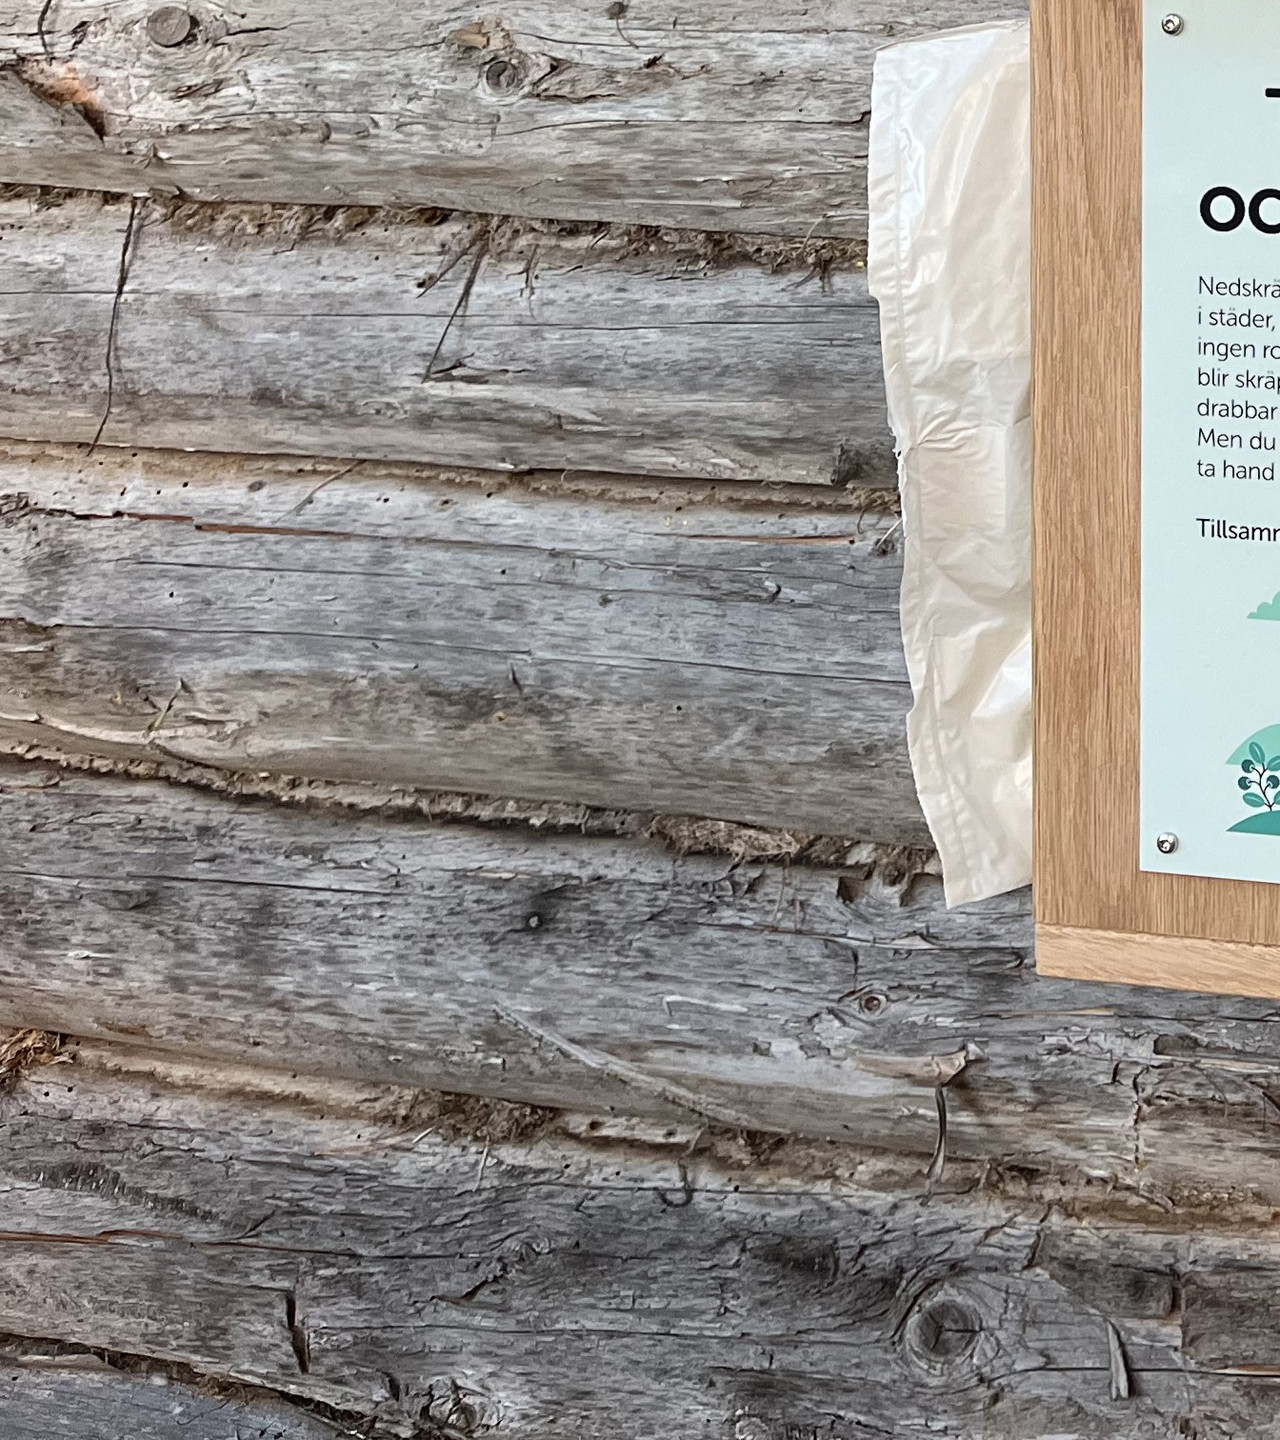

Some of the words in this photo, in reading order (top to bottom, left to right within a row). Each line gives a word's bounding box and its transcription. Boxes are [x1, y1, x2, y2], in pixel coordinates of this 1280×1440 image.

[1198, 306, 1201, 324] i
[1209, 307, 1275, 332] städer,
[1198, 336, 1255, 361] ingen
[1198, 367, 1229, 387] blir
[1197, 398, 1278, 420] drabbar
[1198, 428, 1242, 448] Men
[1250, 431, 1275, 450] du
[1197, 460, 1215, 477] ta
[1223, 459, 1274, 481] hand
